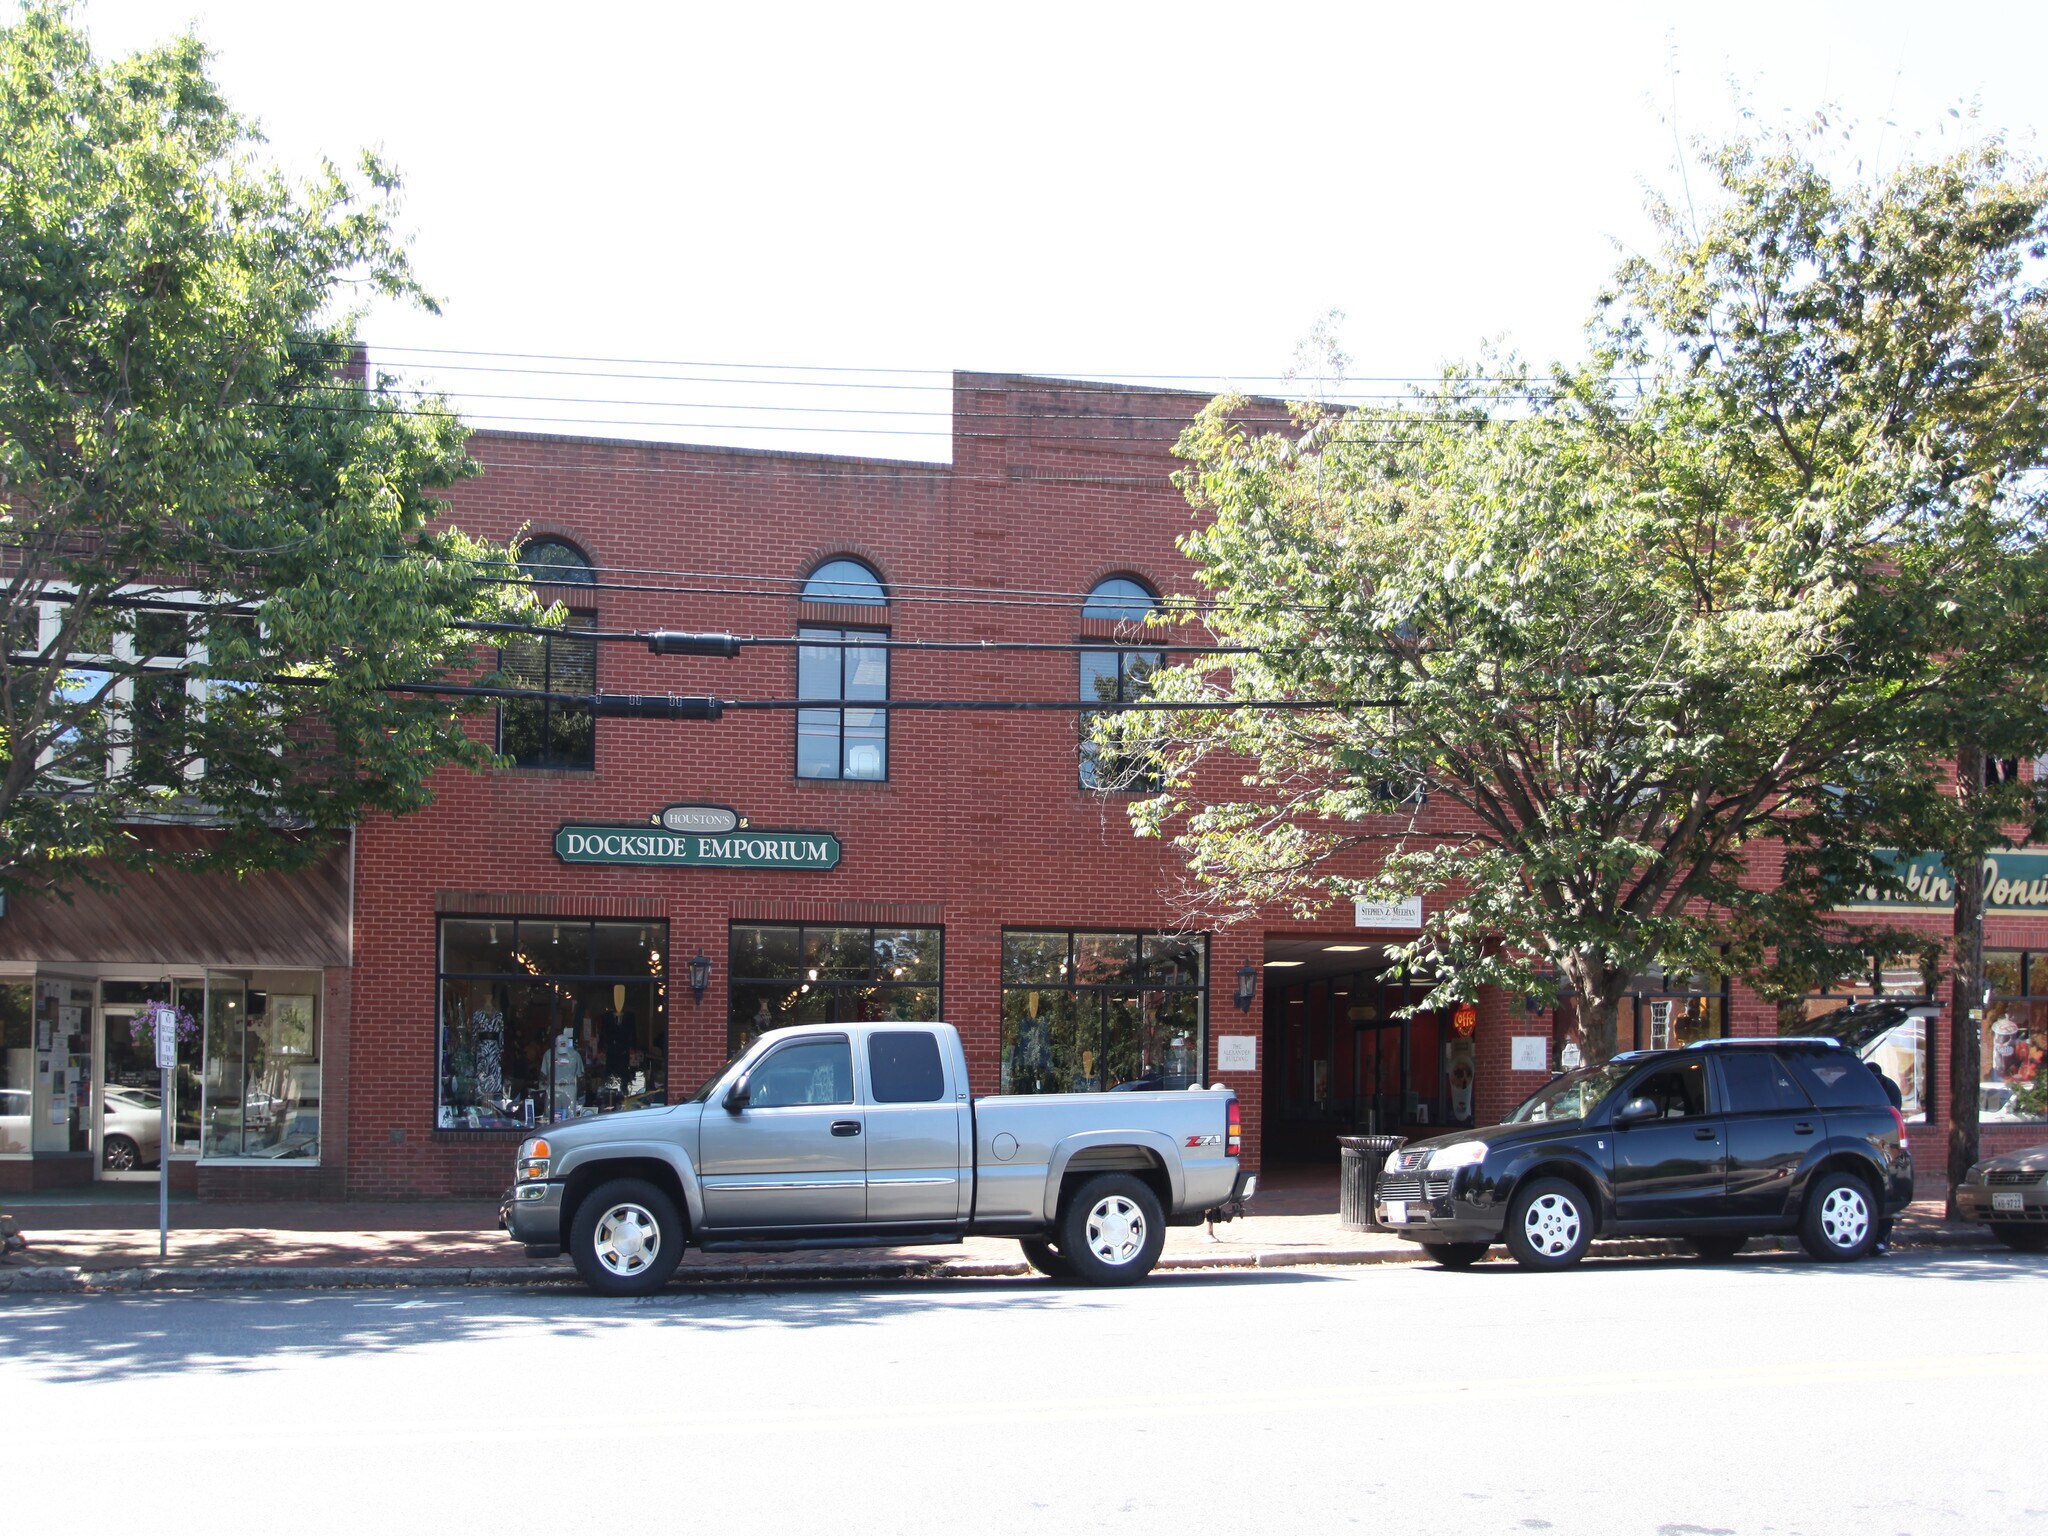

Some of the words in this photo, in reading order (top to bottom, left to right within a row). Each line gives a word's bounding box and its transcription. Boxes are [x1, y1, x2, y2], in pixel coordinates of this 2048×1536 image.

[669, 814, 731, 826] HOUSTON'S
[567, 833, 687, 858] DOCKSIDE
[697, 838, 829, 861] EMPORIUM
[1983, 858, 2048, 905] Donu
[1454, 1011, 1476, 1028] Coffe
[1184, 1135, 1221, 1147] Z71
